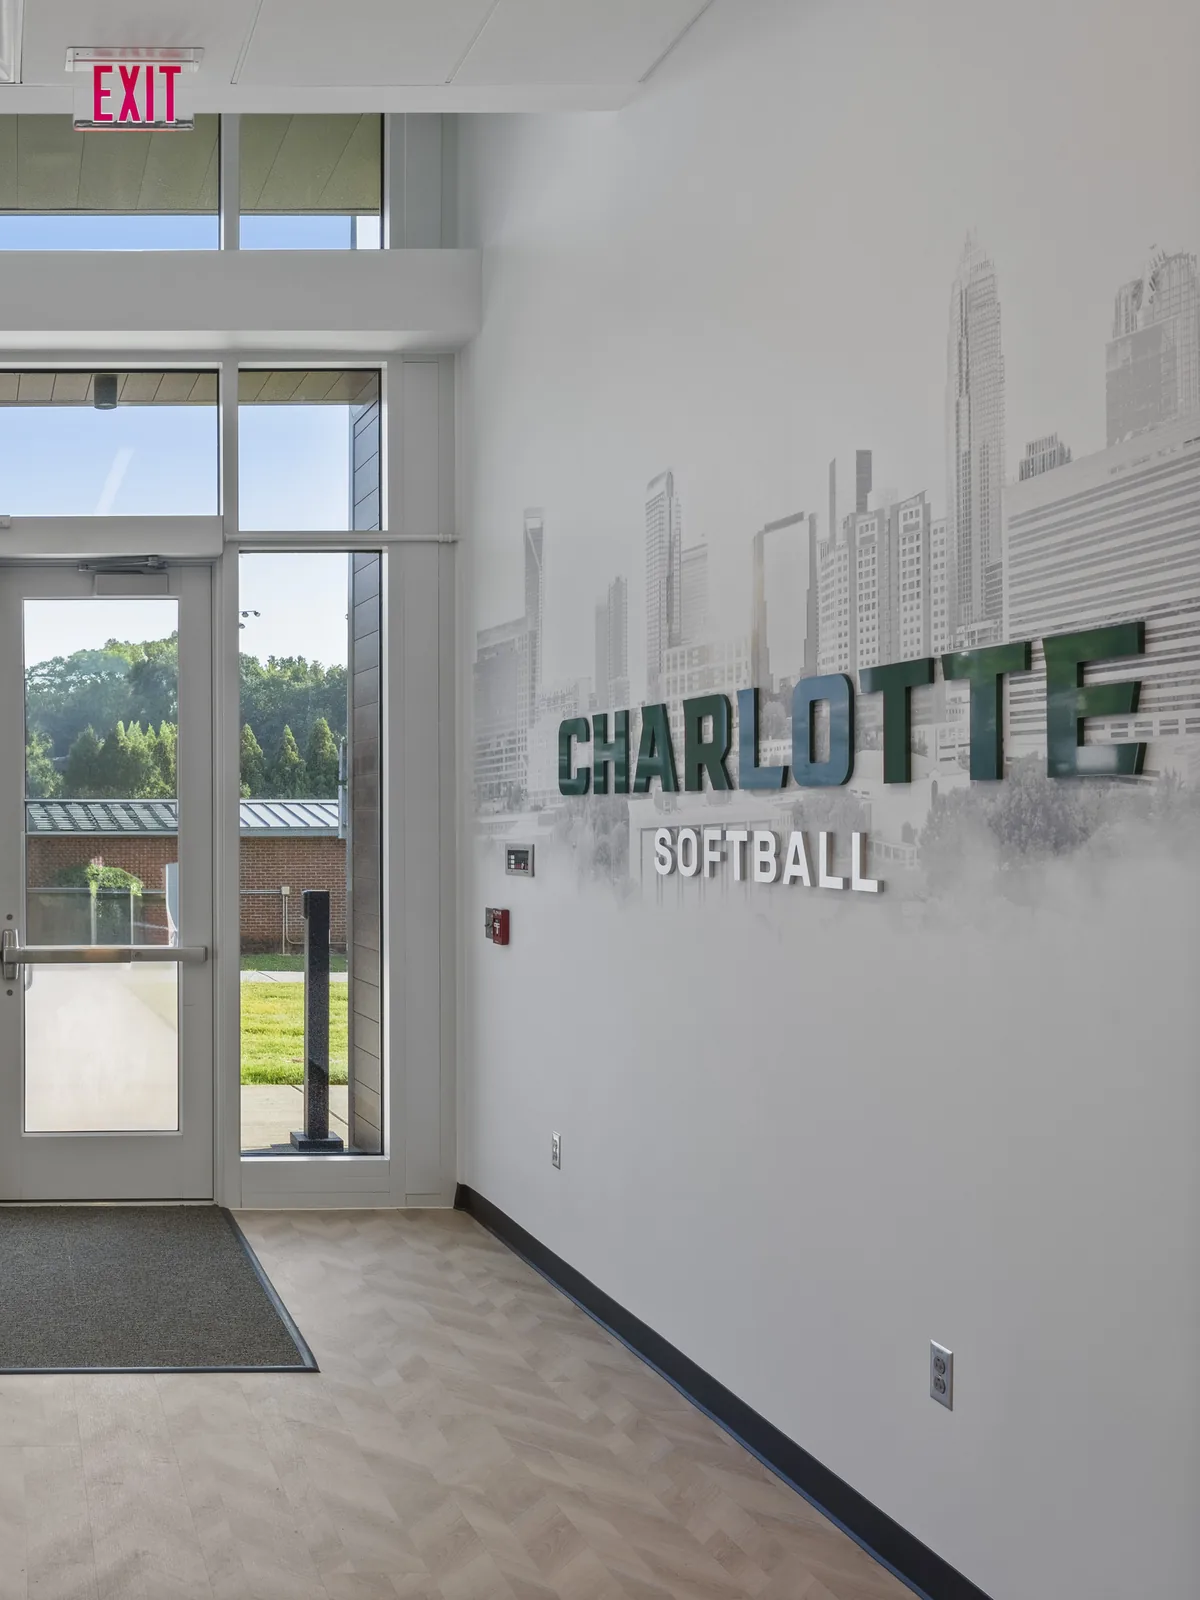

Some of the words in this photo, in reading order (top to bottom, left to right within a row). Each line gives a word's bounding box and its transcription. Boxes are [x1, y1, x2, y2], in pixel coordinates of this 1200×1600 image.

[93, 65, 182, 122] EXIT
[558, 621, 1146, 796] CHARLOTTE
[653, 827, 885, 893] SOFTBALL
